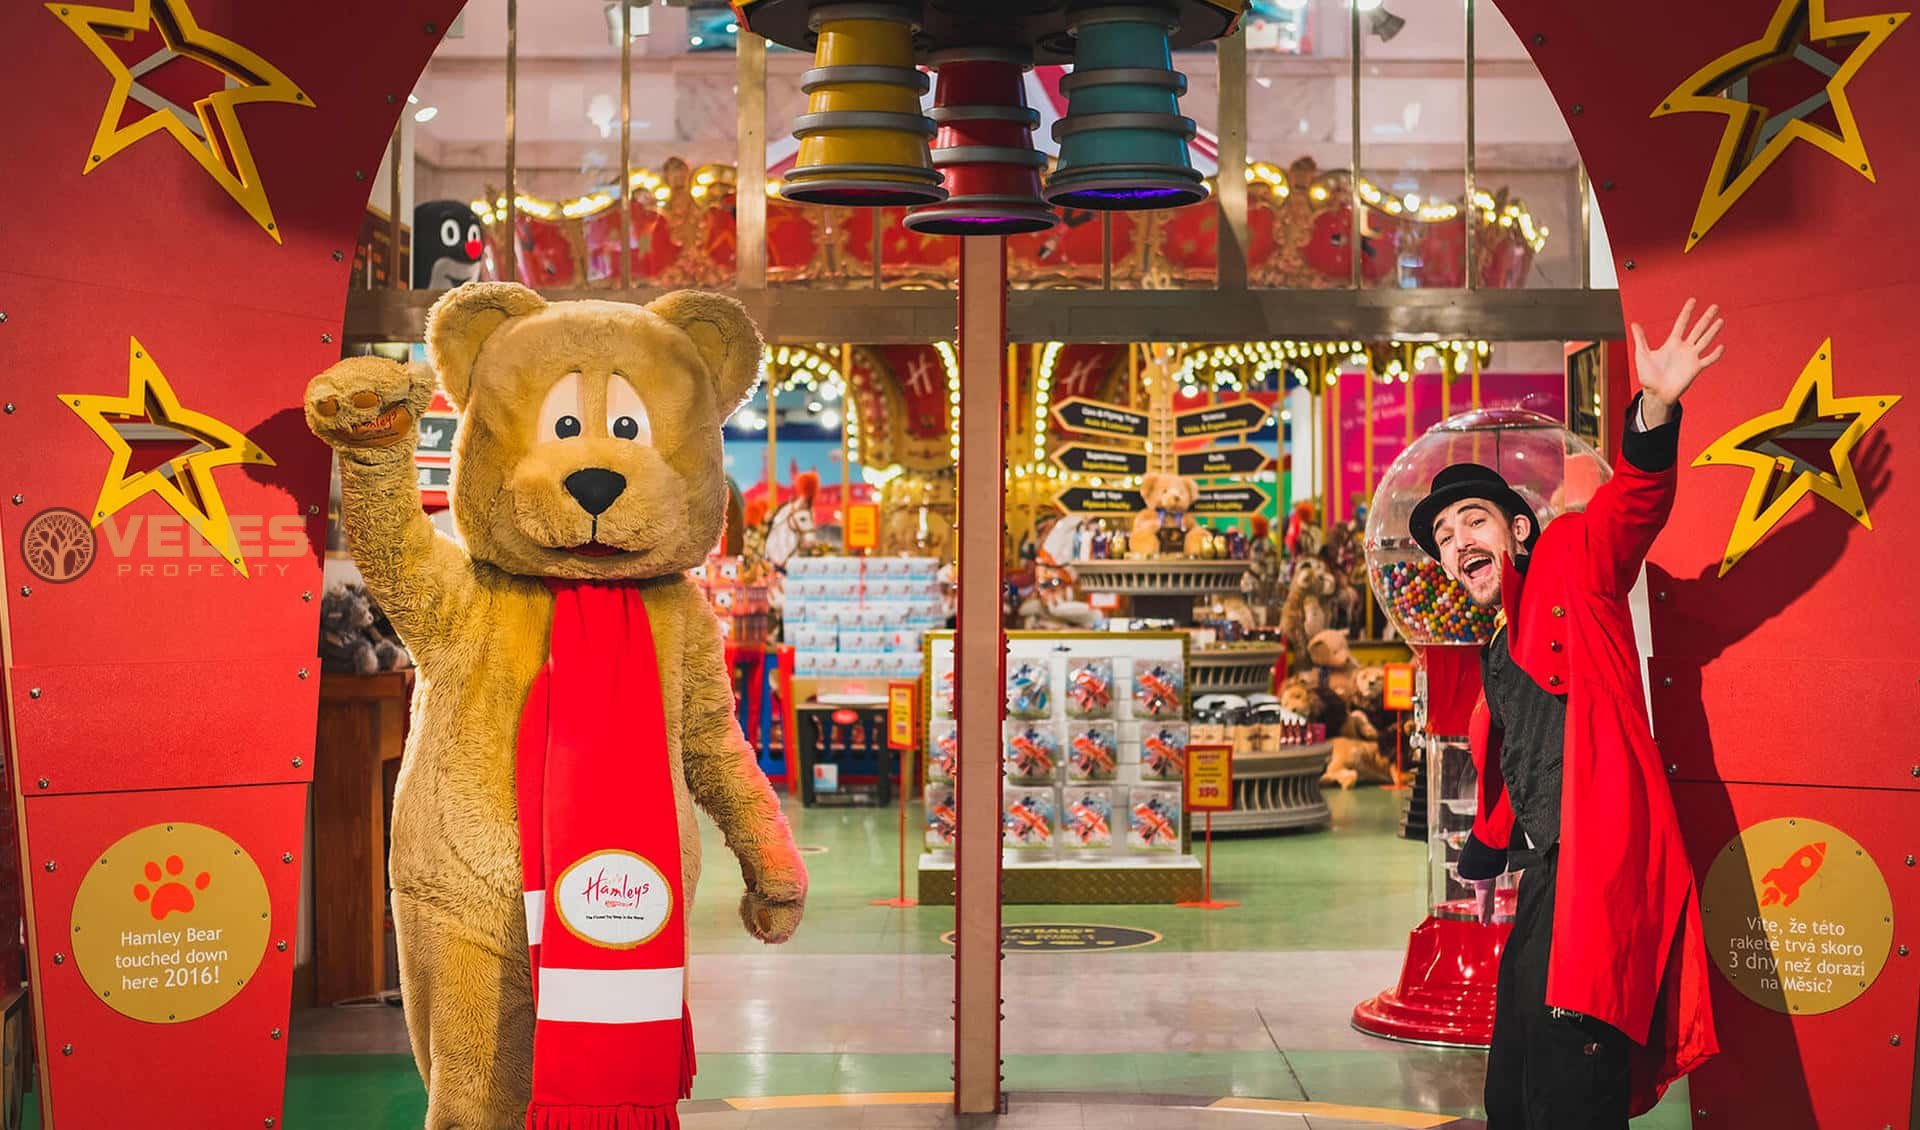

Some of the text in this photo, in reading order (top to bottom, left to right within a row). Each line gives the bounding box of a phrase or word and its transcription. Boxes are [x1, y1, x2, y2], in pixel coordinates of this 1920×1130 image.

[581, 867, 651, 909] Hamleys
[1746, 917, 1846, 937] Víte, že této
[121, 928, 223, 947] Hamley Bear
[1730, 936, 1864, 957] raketě trvá skoro
[115, 949, 228, 969] touched down
[1728, 951, 1865, 977] 3 dny než dorazí
[121, 965, 220, 991] here 2016!
[1760, 976, 1834, 993] na Měsíc?
